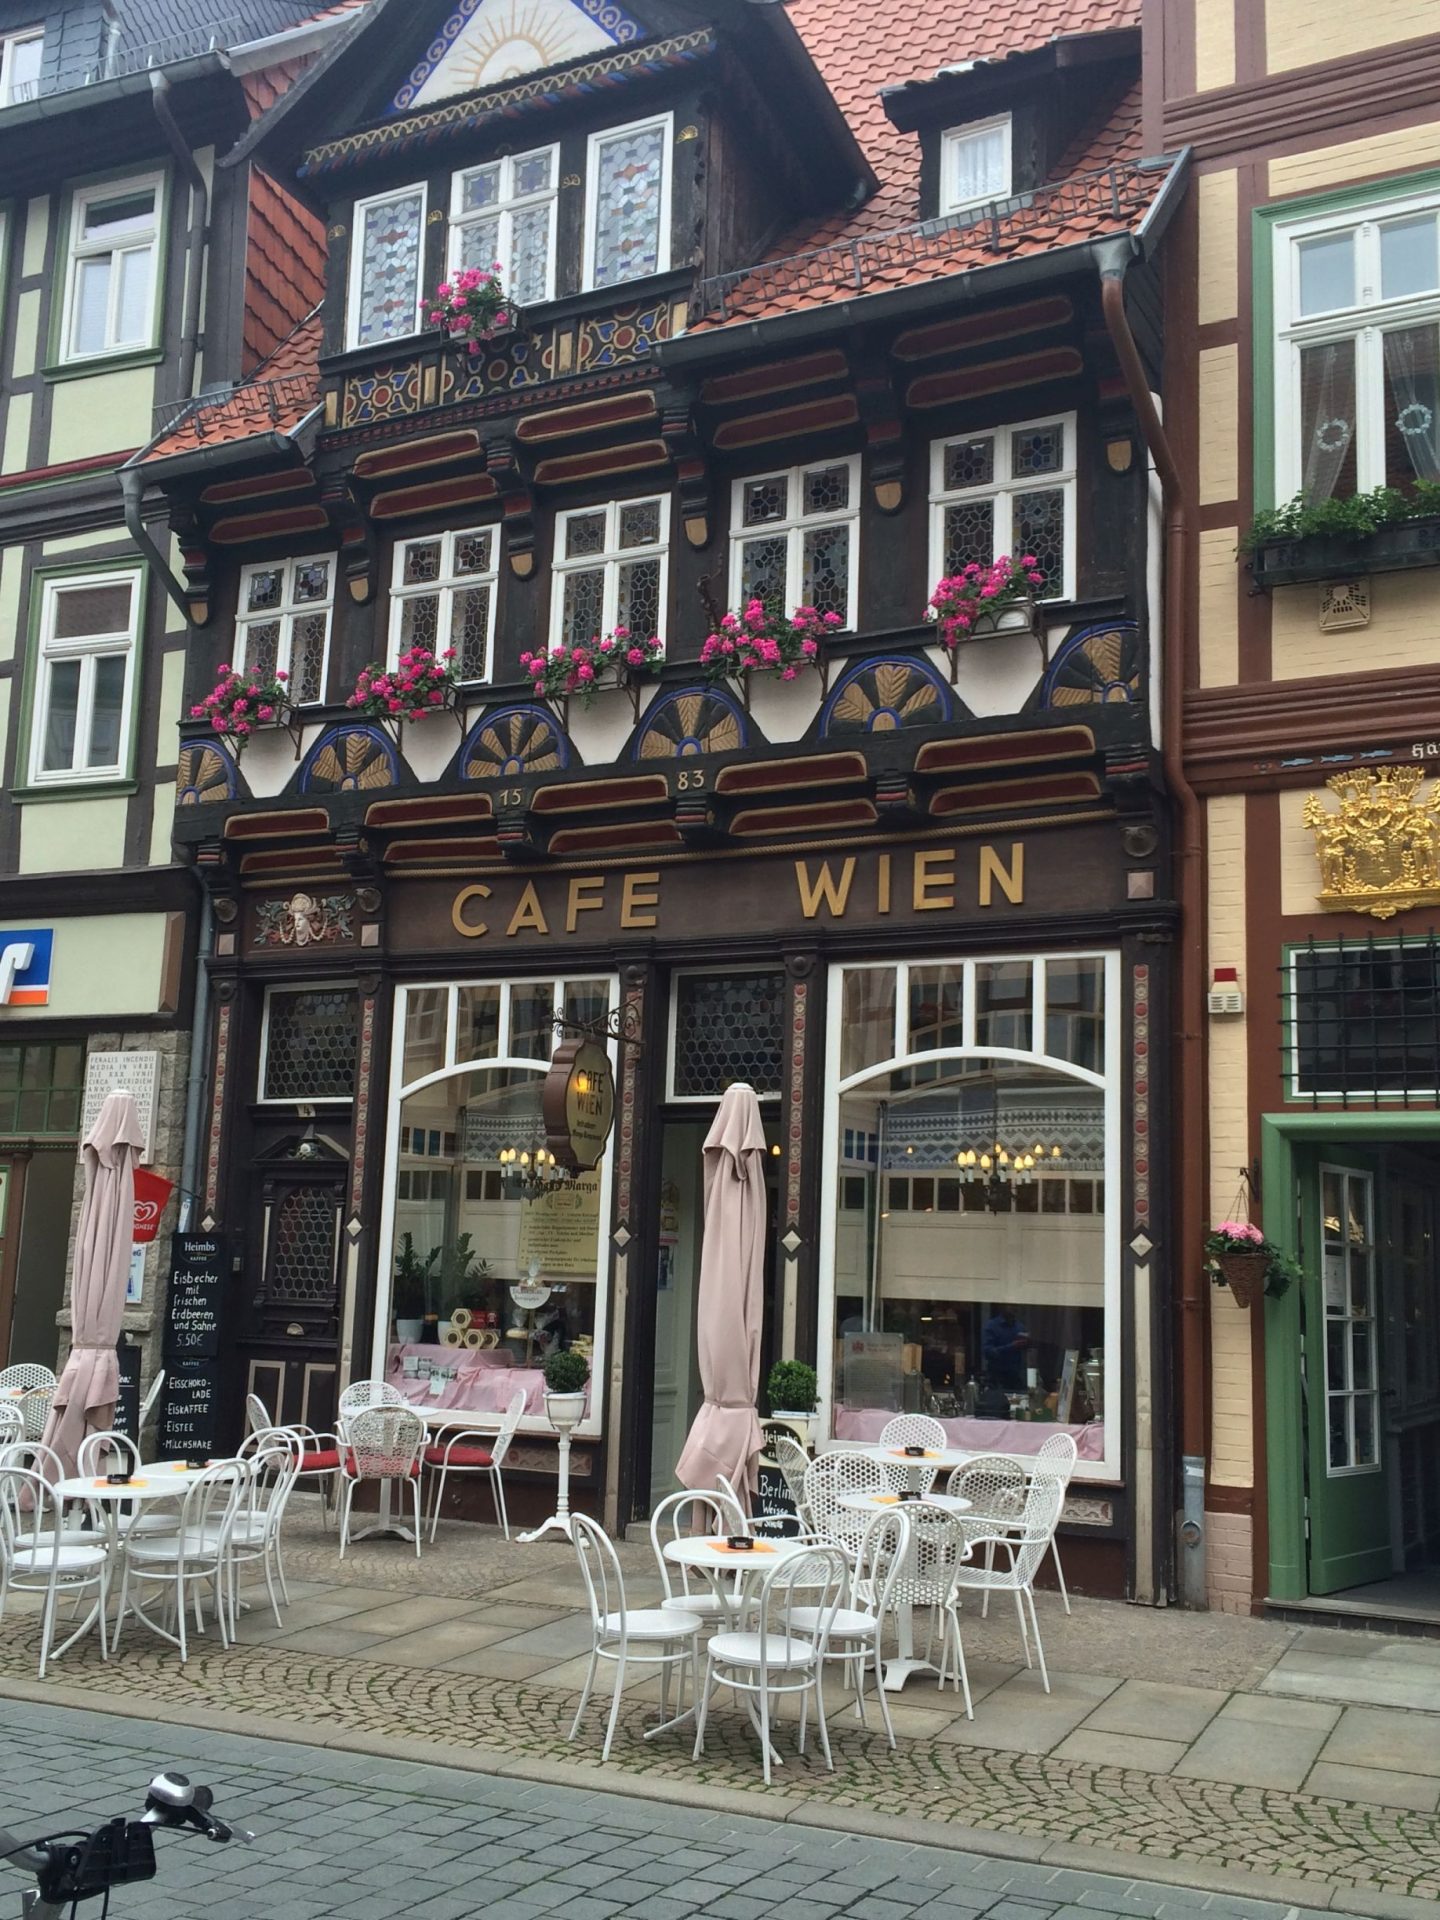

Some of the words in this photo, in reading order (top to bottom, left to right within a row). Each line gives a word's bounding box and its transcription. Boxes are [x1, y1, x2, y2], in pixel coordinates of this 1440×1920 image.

[500, 788, 522, 806] 15
[678, 769, 705, 791] 83
[451, 871, 661, 938] CAFE
[794, 841, 1025, 919] WIEN
[576, 1091, 603, 1115] WIEN
[184, 1241, 216, 1252] Heimbs
[173, 1271, 218, 1285] Eisbecher
[185, 1284, 200, 1295] mit
[173, 1294, 207, 1307] frischen
[171, 1308, 214, 1320] Erdbeeren
[174, 1320, 190, 1330] und
[191, 1320, 217, 1331] Sahne
[191, 1389, 212, 1399] LADE
